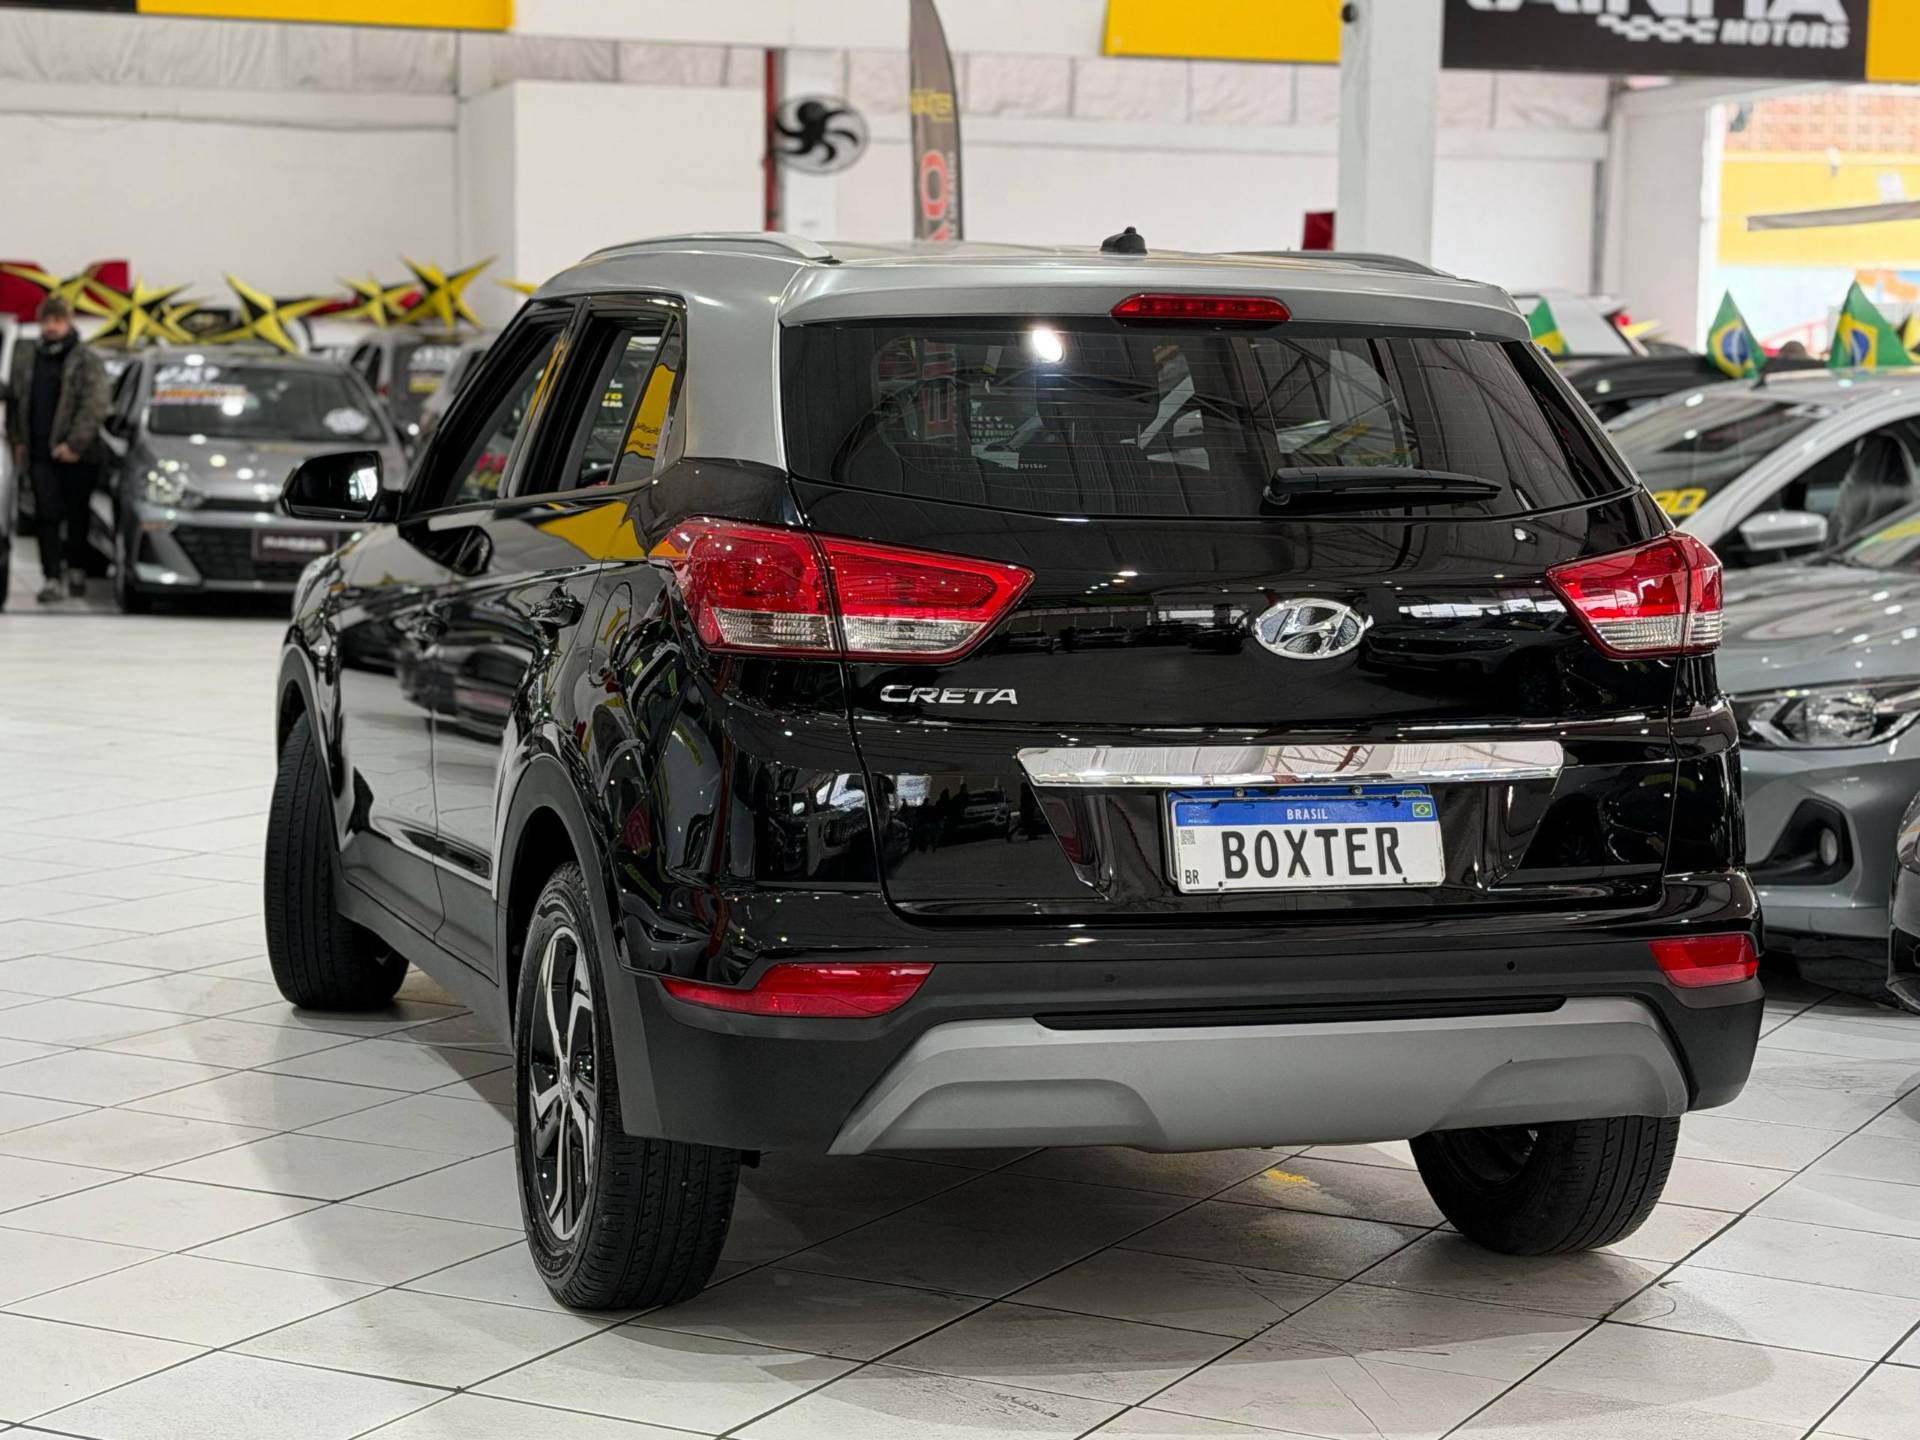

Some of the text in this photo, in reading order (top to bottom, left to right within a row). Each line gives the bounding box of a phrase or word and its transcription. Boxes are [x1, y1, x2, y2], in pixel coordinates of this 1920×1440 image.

[1720, 18, 1850, 48] MOTORS
[880, 685, 1018, 704] CRETA
[1286, 808, 1328, 820] BRASIL
[1221, 826, 1403, 879] BOXTER
[1184, 869, 1200, 885] BR
